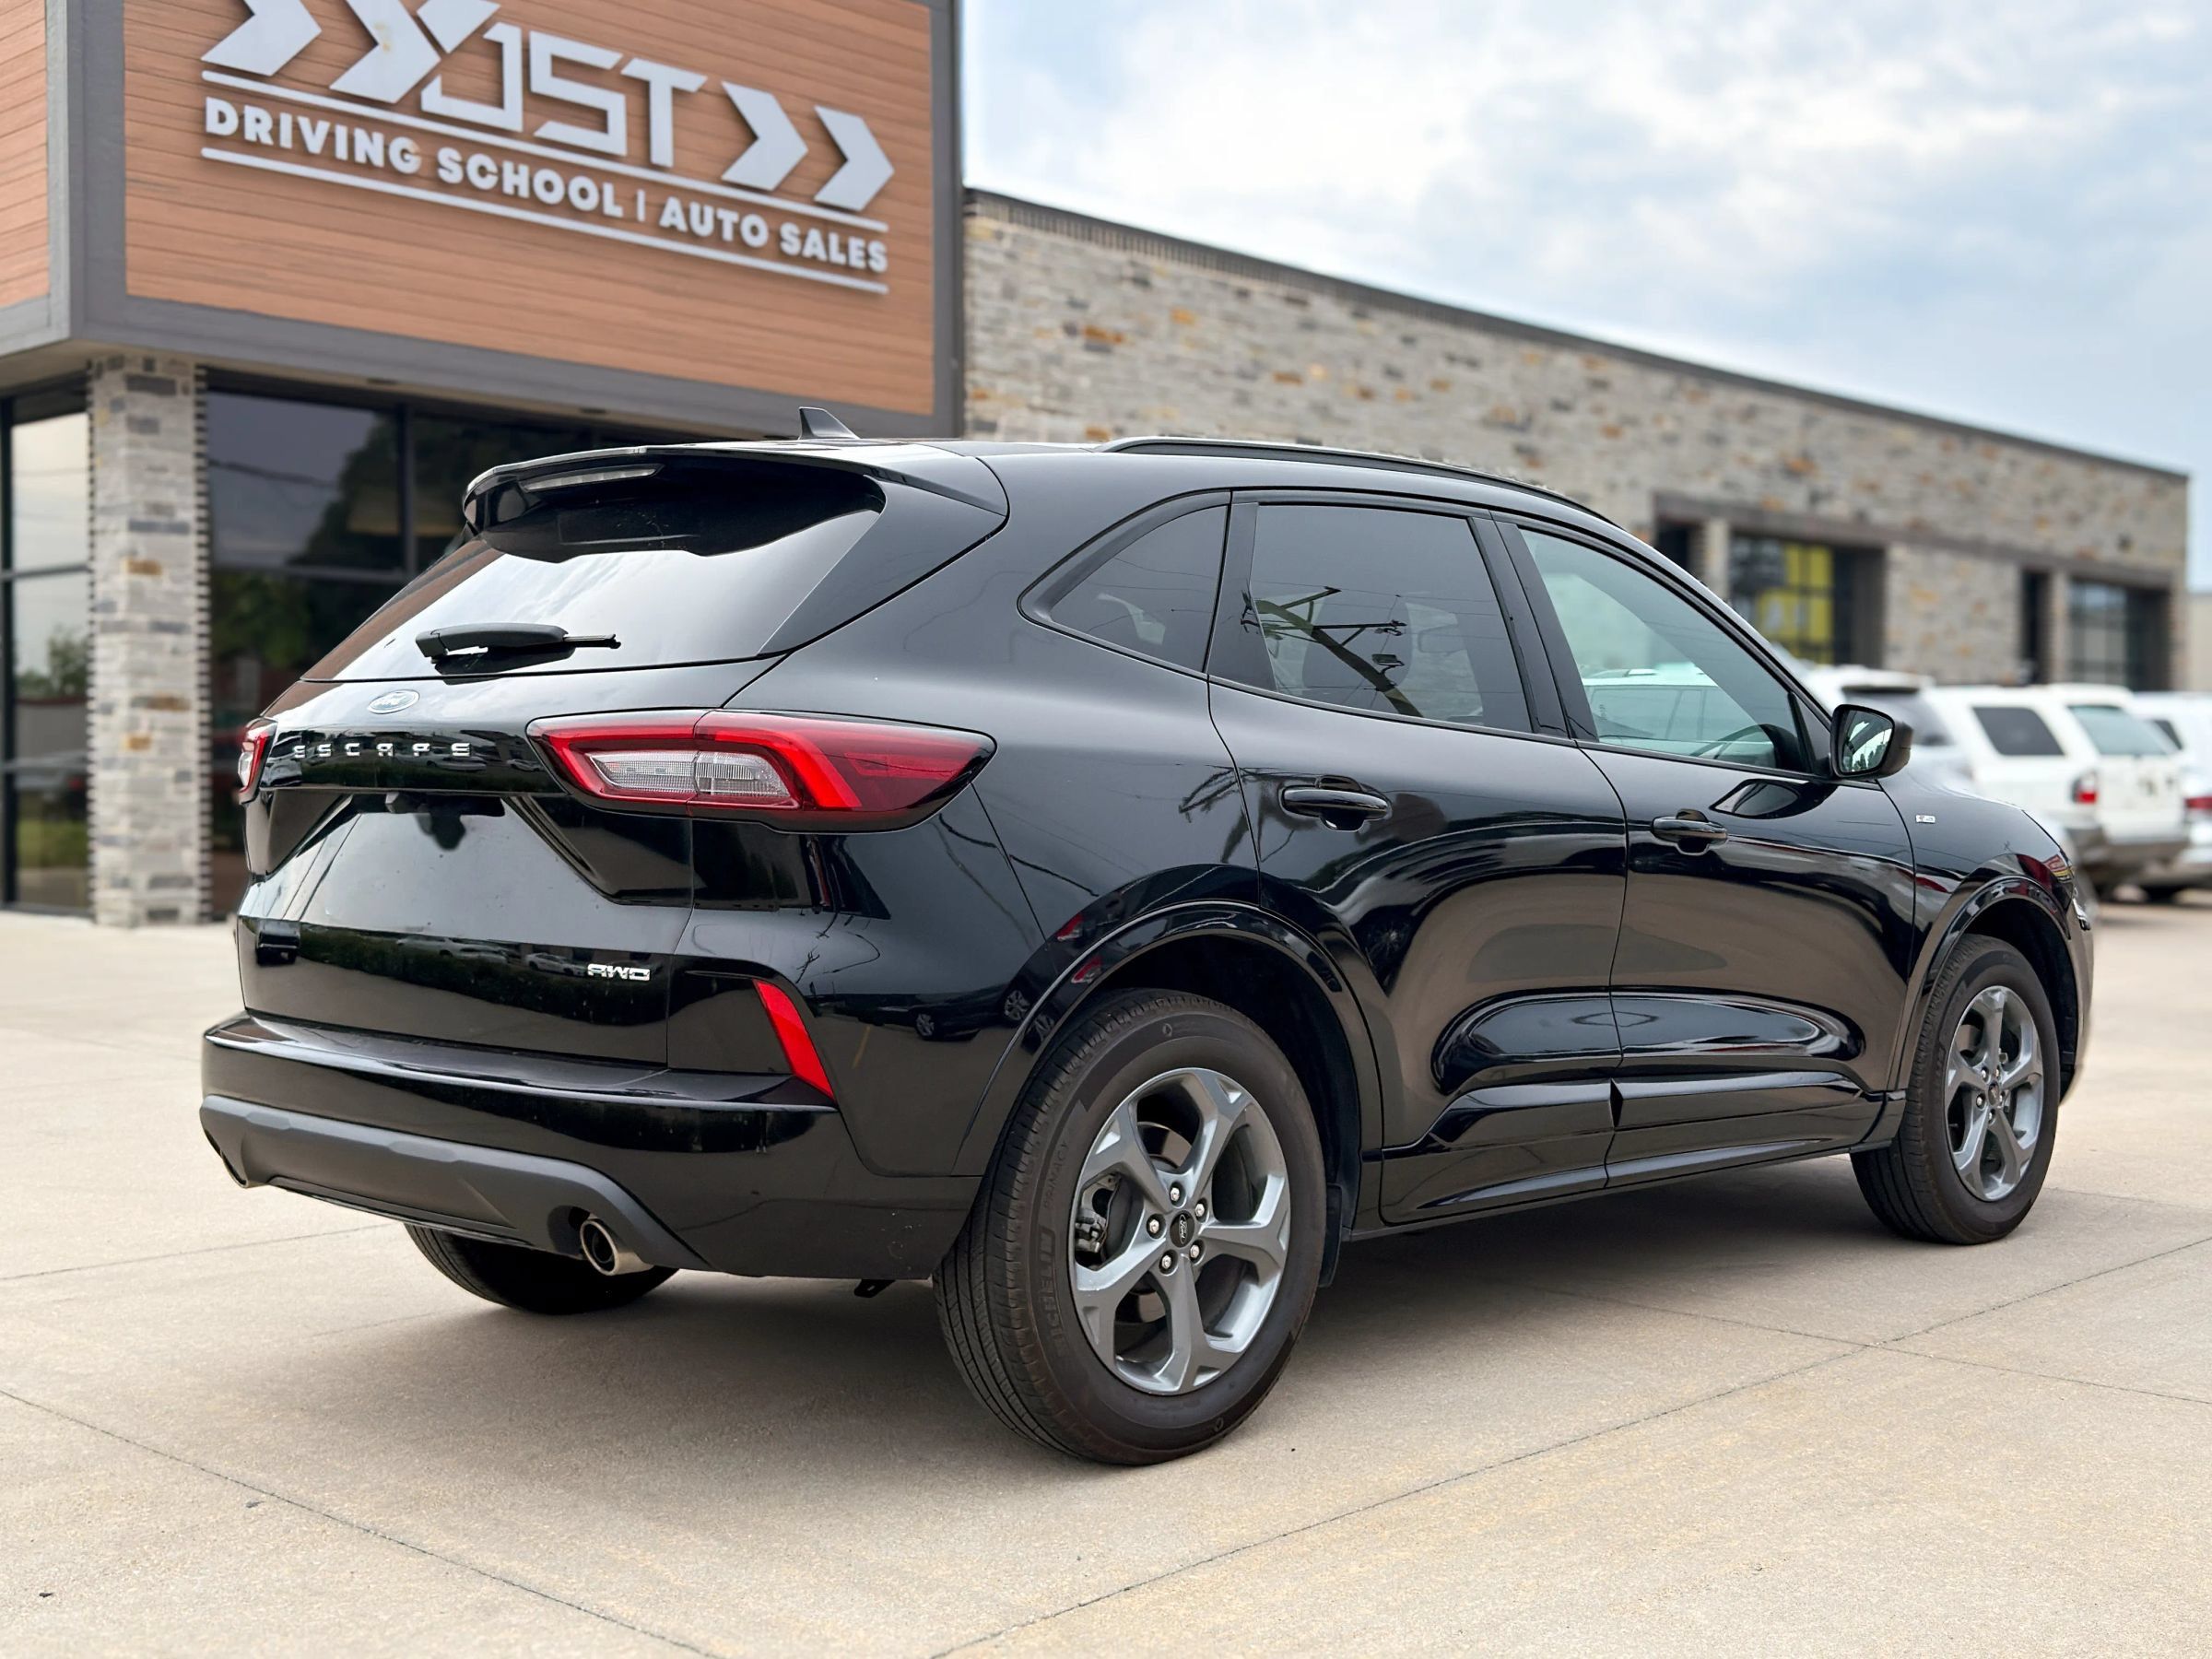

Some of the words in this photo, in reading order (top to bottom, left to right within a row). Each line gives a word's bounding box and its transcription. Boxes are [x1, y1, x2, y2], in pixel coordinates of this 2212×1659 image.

[205, 96, 422, 174] DRIVING
[436, 146, 624, 218] SCHOOL
[659, 195, 769, 248] AUTO
[780, 221, 888, 273] SALES
[293, 742, 471, 759] ESCAPE
[587, 963, 651, 982] AWD
